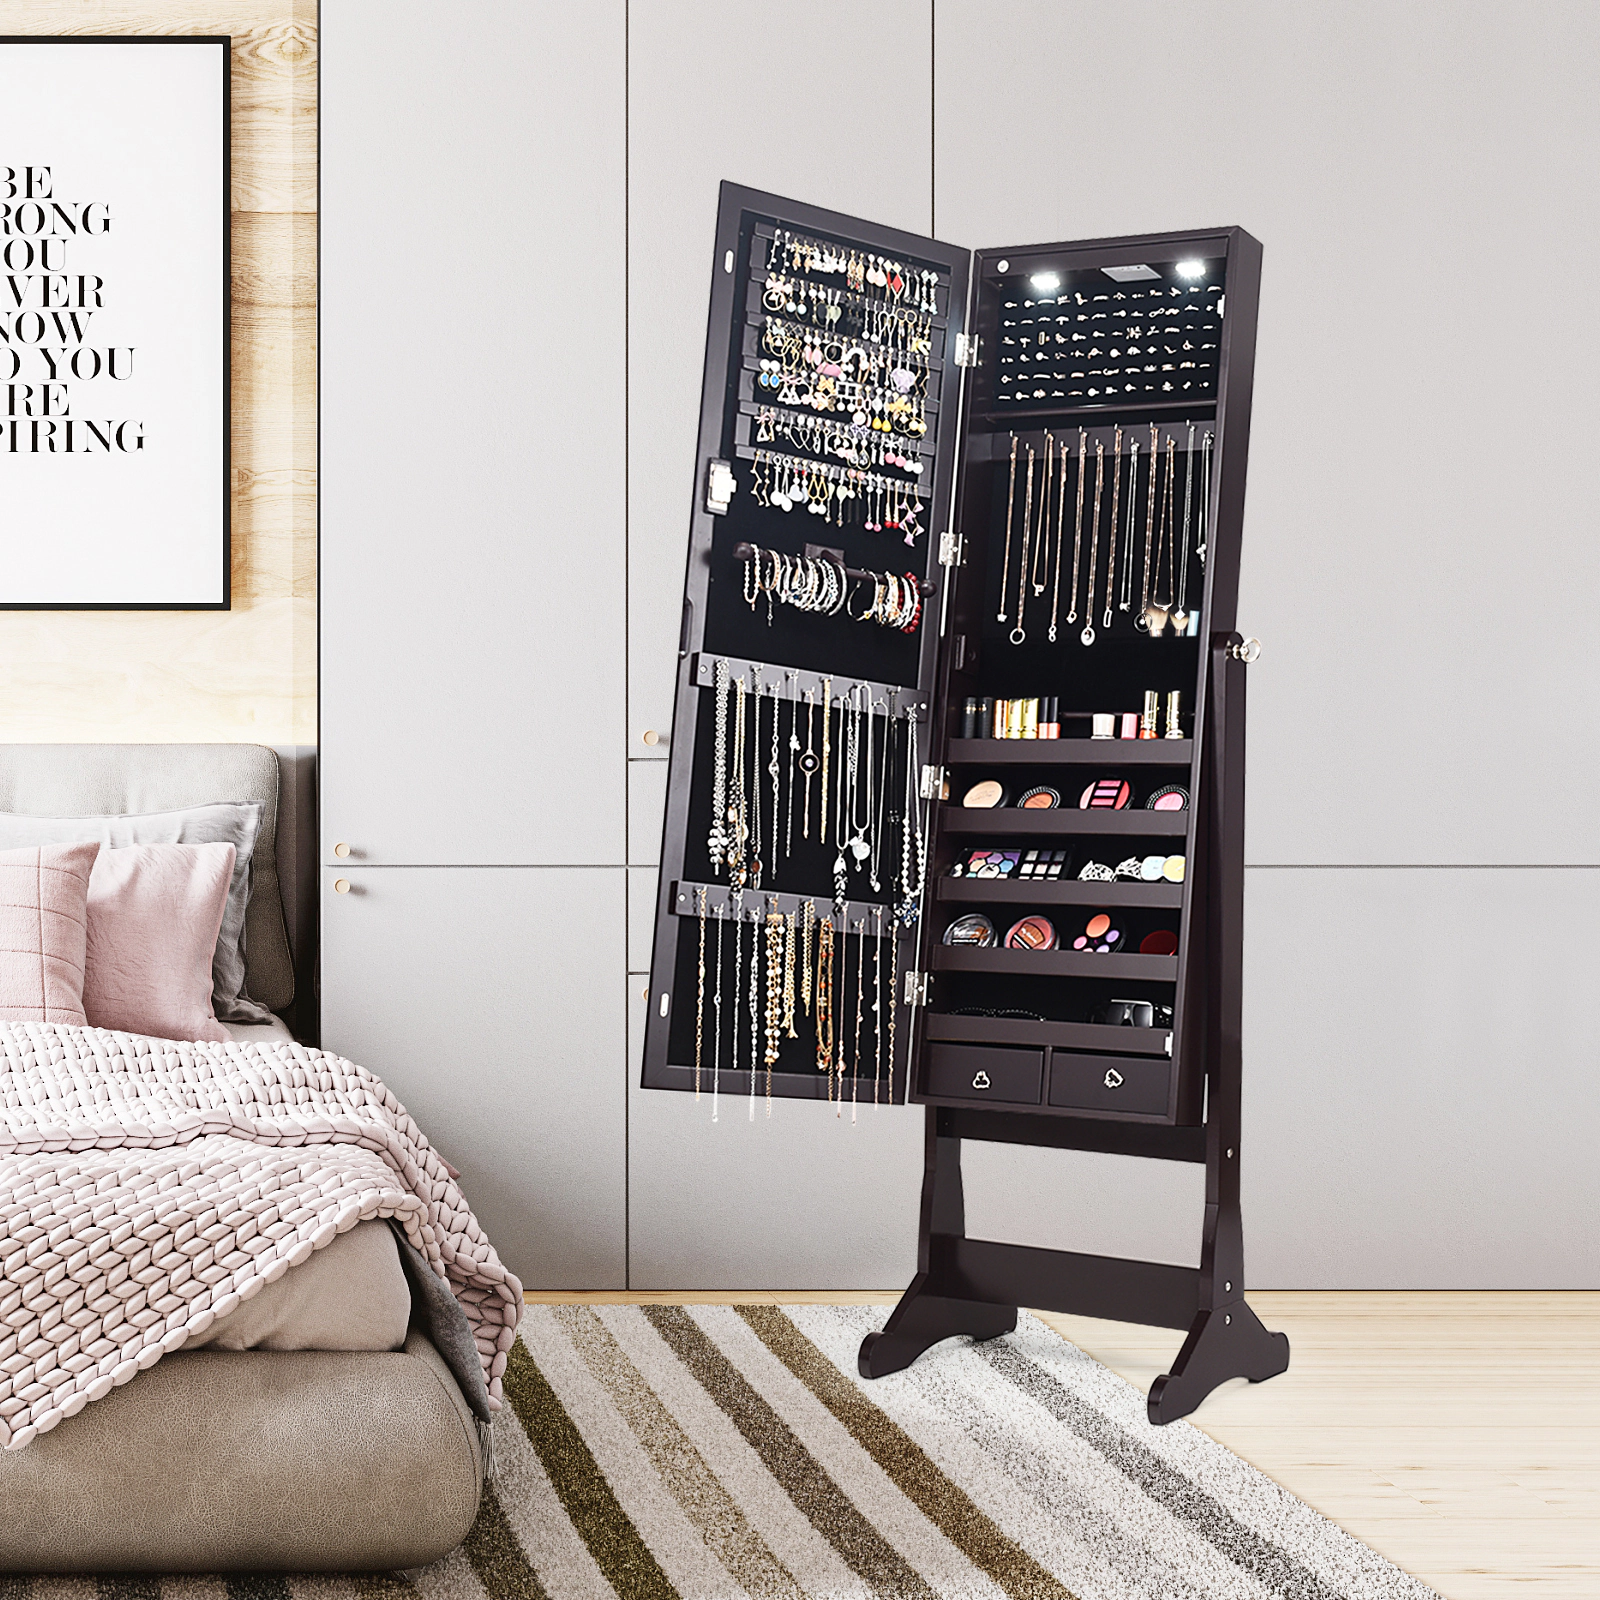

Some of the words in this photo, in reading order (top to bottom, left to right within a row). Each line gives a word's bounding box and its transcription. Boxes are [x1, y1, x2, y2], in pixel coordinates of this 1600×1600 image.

[5, 275, 106, 308] VER
[39, 348, 137, 380] YOU
[0, 420, 148, 453] IRING
